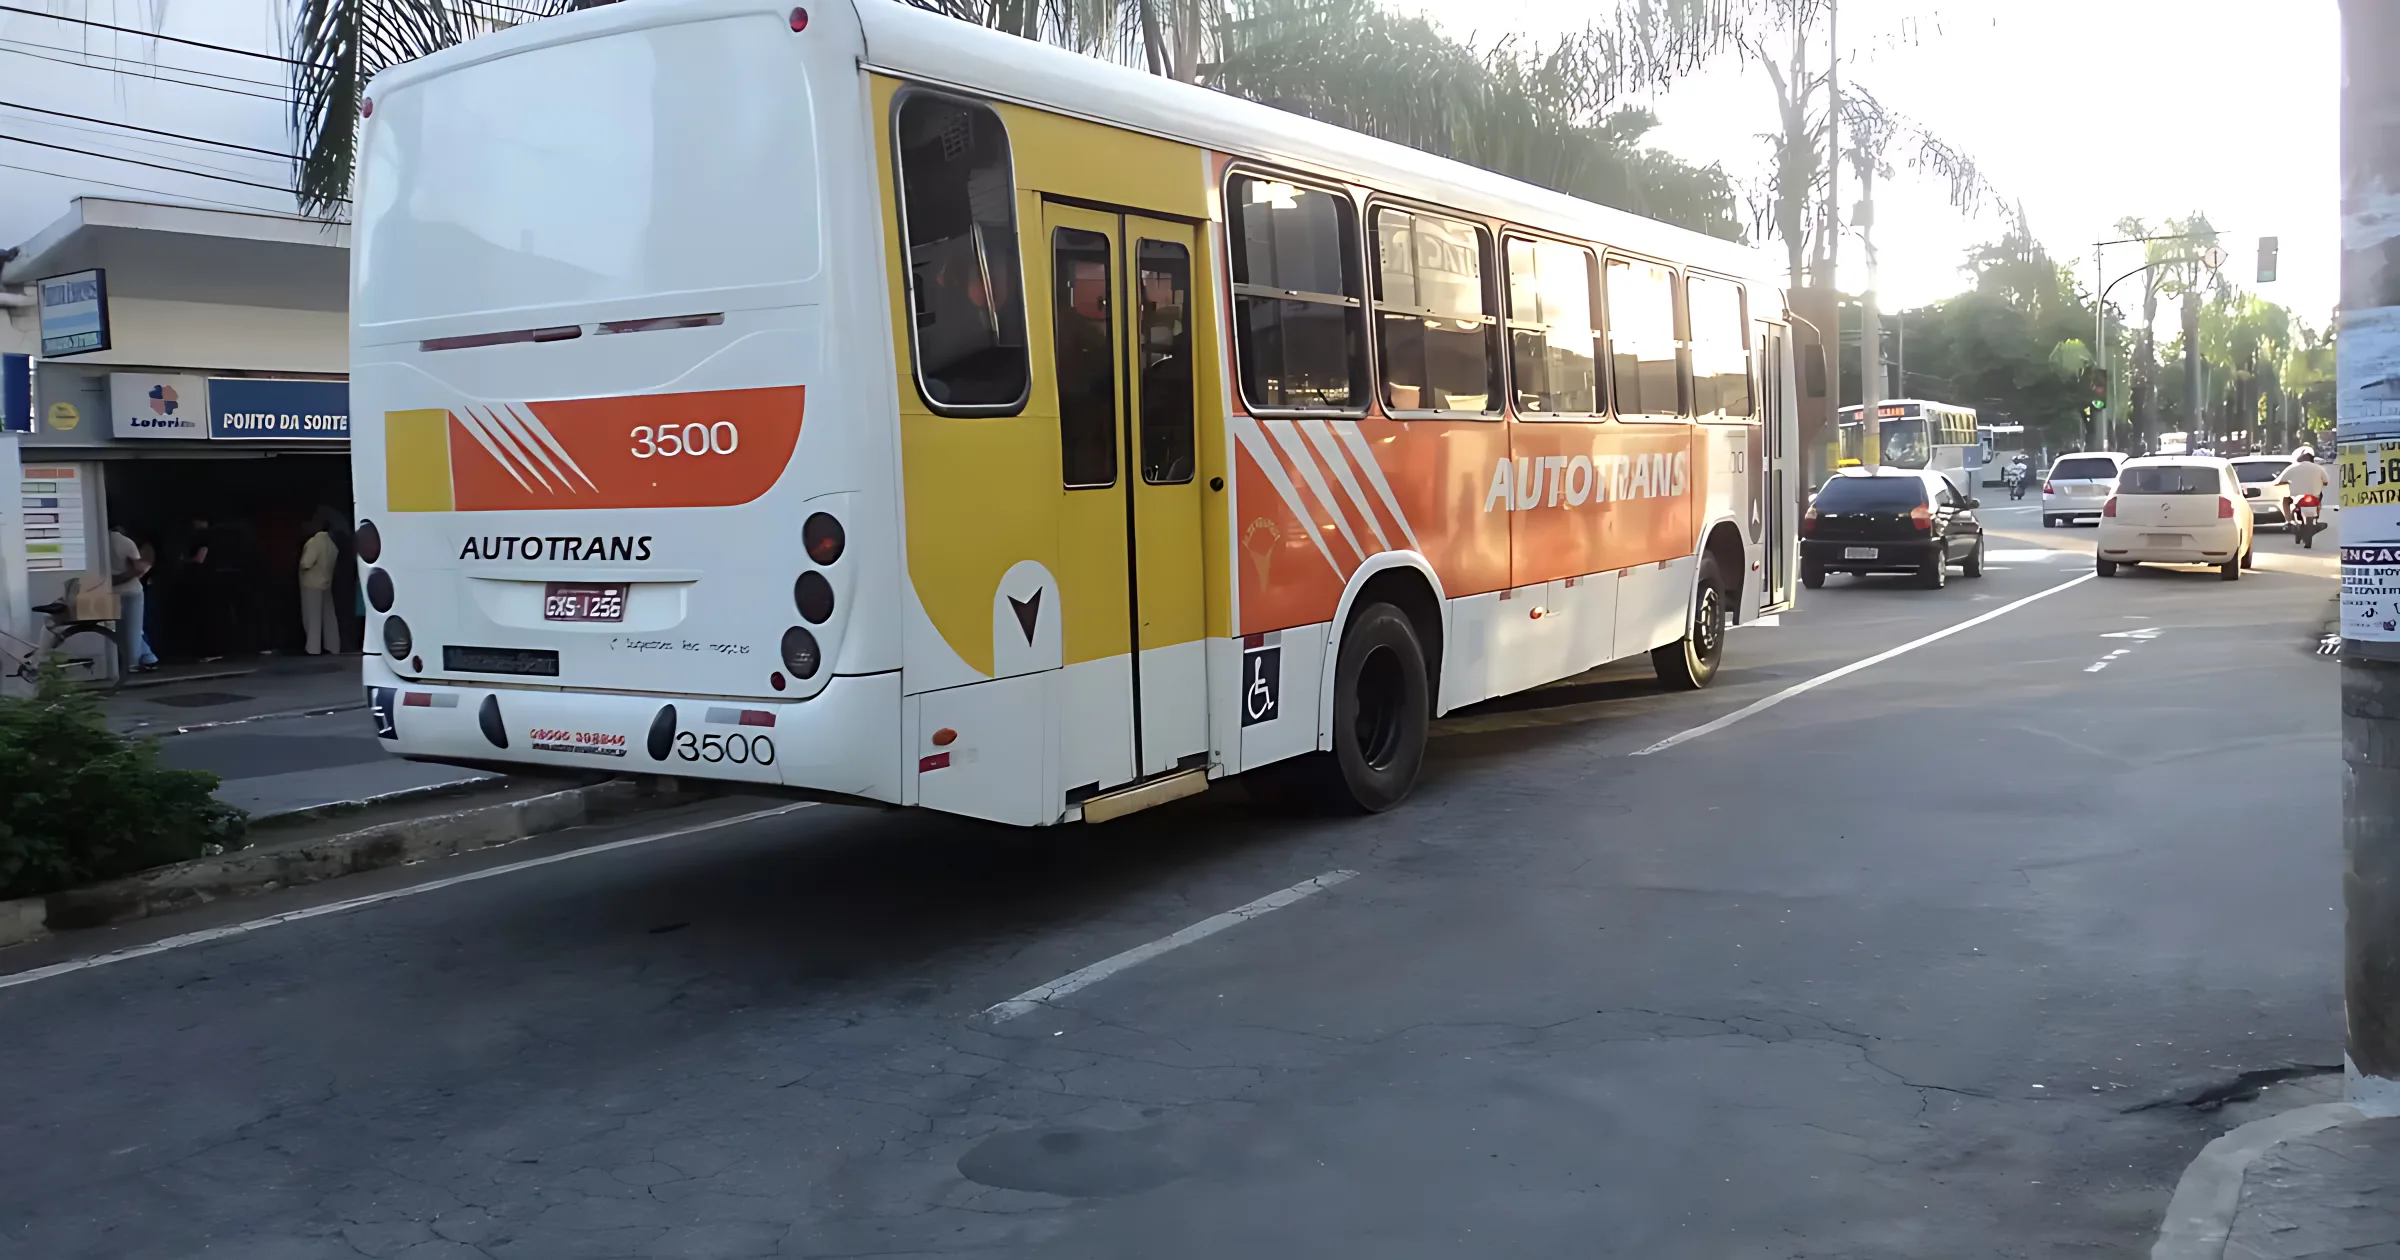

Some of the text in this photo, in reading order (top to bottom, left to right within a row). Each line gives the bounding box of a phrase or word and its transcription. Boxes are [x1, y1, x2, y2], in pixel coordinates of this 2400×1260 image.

[223, 413, 348, 431] PONTO DA SORTE
[630, 420, 739, 459] 3500
[1484, 450, 1689, 513] AUTOTRANS
[459, 535, 653, 561] AUTOTRANS
[676, 730, 775, 766] 3500
